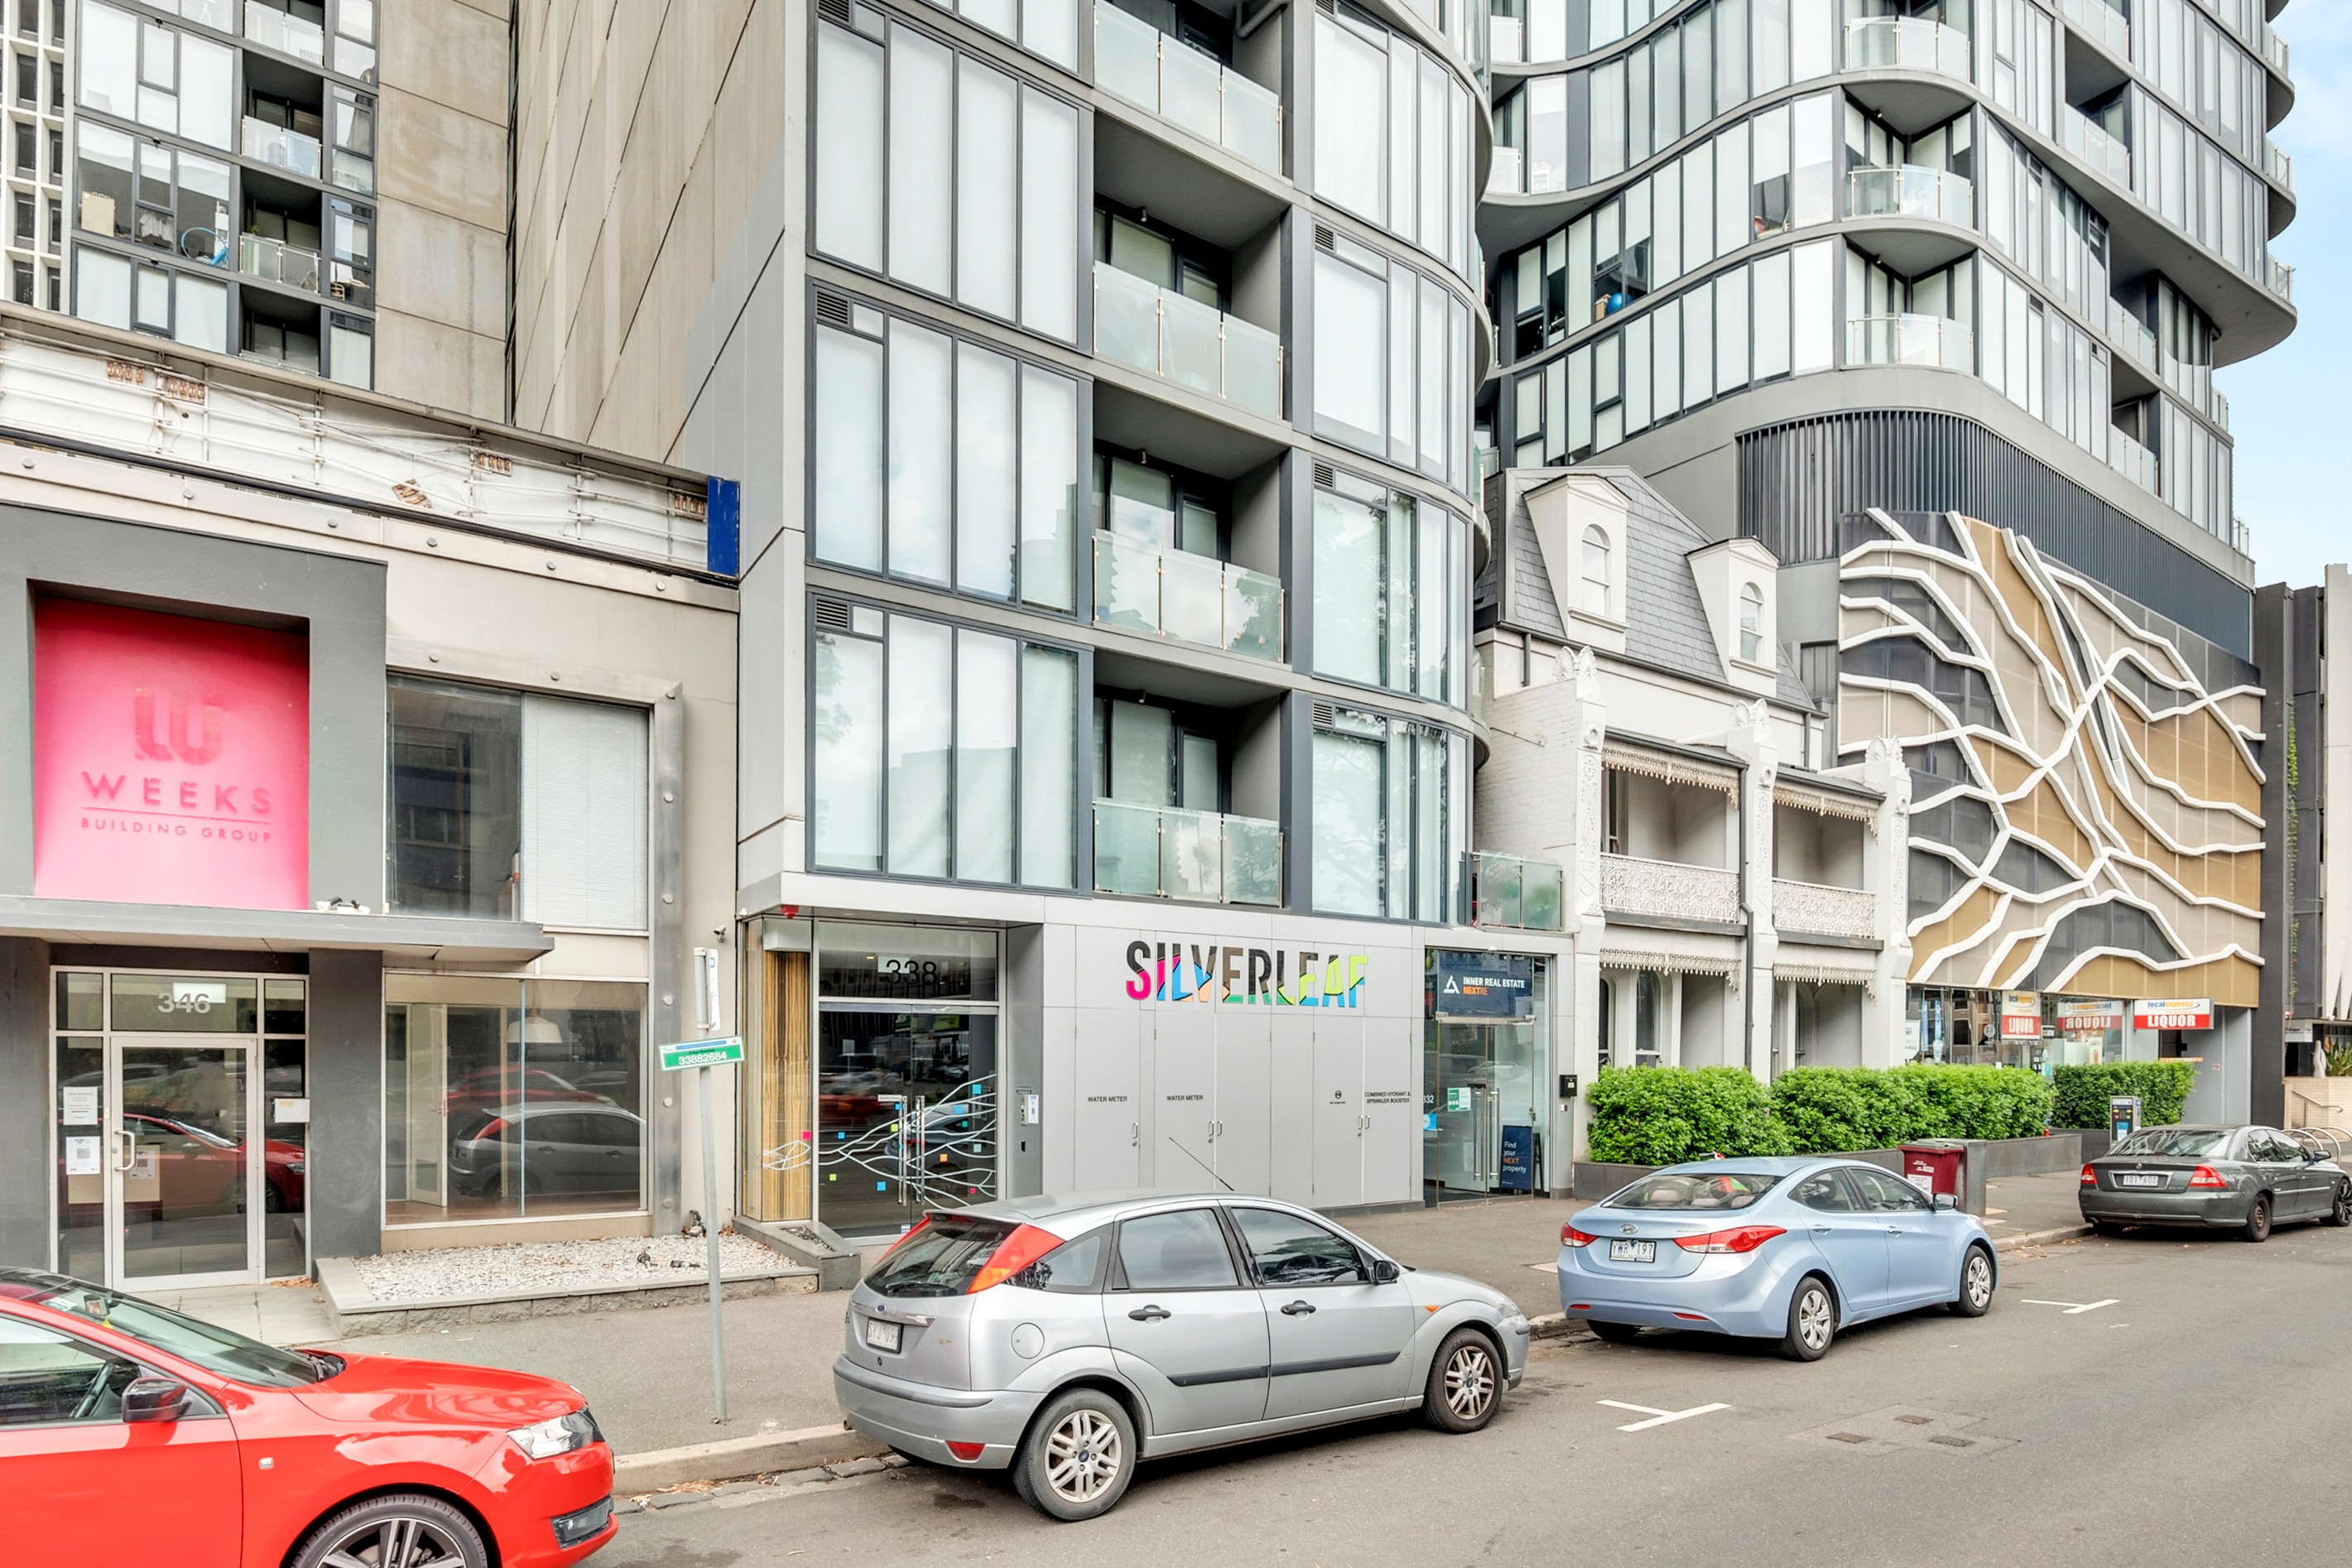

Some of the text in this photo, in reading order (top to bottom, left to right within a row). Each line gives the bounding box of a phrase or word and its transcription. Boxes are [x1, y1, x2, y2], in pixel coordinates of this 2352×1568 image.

[81, 770, 272, 815] WEEKS
[81, 817, 272, 842] BUILDING GROUP
[886, 959, 937, 986] 338
[1125, 940, 1368, 1008] SILVERLEAF
[1462, 976, 1525, 988] INNER REAL ESTATE
[157, 993, 211, 1014] 346
[2008, 1017, 2034, 1034] LIQUOR
[2148, 1014, 2196, 1028] LIQUOR
[678, 1051, 728, 1065] 33882684
[1503, 1165, 1527, 1174] property
[1637, 1243, 1654, 1256] 197
